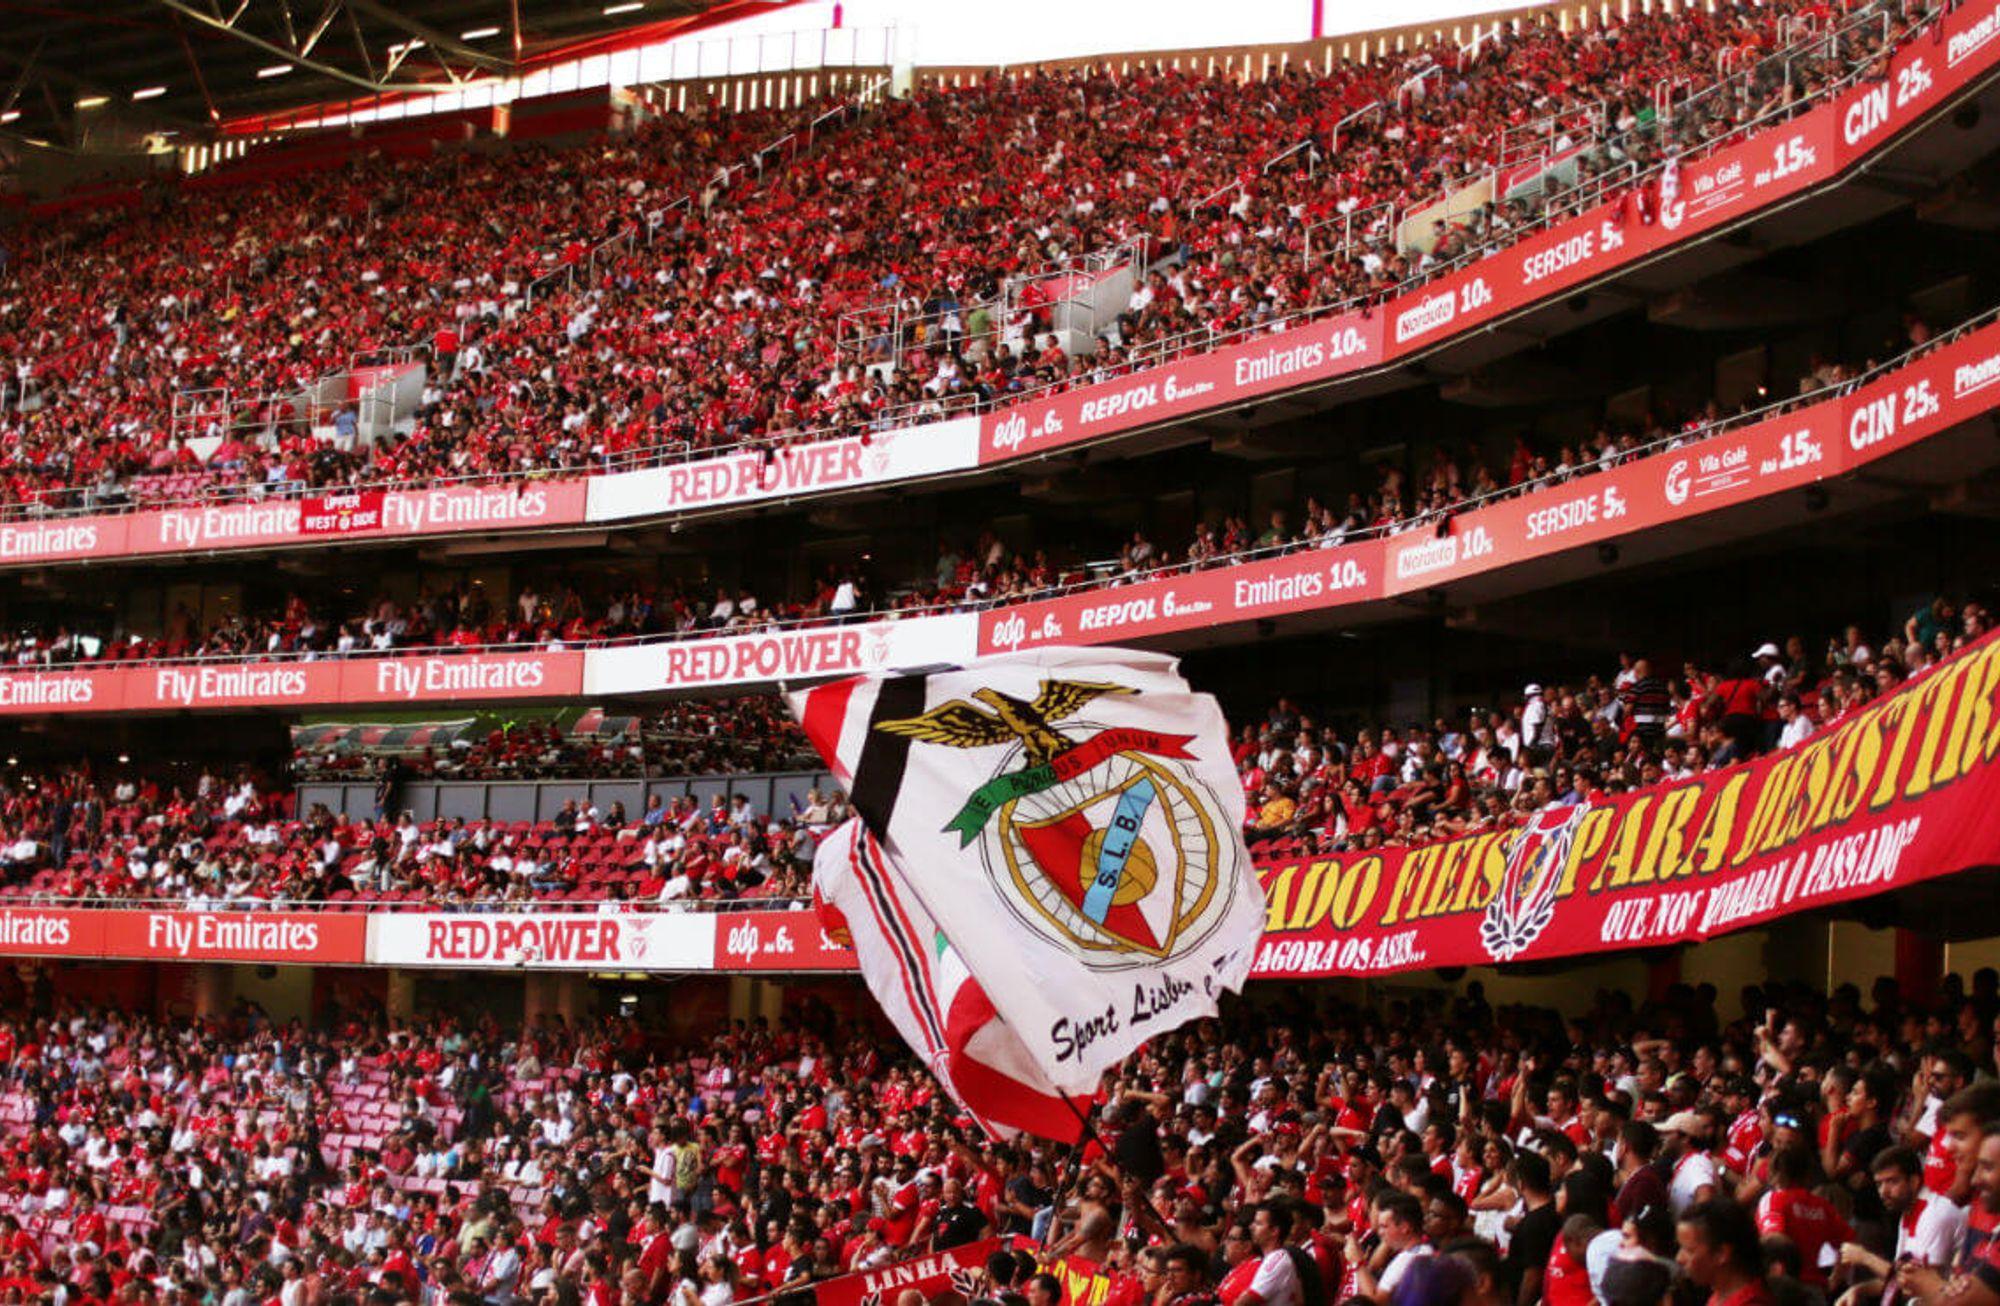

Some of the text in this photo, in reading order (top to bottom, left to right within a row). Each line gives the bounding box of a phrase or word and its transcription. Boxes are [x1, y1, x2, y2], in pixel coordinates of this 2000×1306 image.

[1844, 57, 1933, 145] CIN 25%
[1773, 135, 1816, 180] 15%
[1522, 221, 1624, 285] SEASIDE 5%
[1461, 278, 1492, 314] 10%
[1235, 327, 1367, 387] Emirates 10%
[1079, 384, 1158, 424] REPSOL
[1850, 379, 1940, 451] CIN 25%
[992, 411, 1026, 451] edp
[1779, 429, 1823, 470] 15%
[305, 510, 377, 530] WEST SIDE
[324, 494, 361, 511] UPPER
[381, 490, 547, 531] Fly Emirates
[1526, 486, 1626, 540] SEASIDE 5%
[0, 525, 97, 556] Emirates
[160, 503, 300, 548] Fly Emirate
[1461, 526, 1493, 560] 10%
[1234, 571, 1322, 608] Emirates
[1329, 559, 1367, 590] 10%
[991, 610, 1026, 651] edp
[1079, 598, 1157, 631] REPSOL
[157, 667, 306, 705] Fly Emirates
[376, 656, 544, 698] Fly Emirates
[1255, 854, 1383, 932] ADO
[1555, 769, 1751, 898] PARA
[1731, 637, 2000, 868] DESISTIR
[149, 914, 319, 956] Fly Emirates
[493, 920, 621, 961] POWER
[727, 919, 759, 963] edp
[1253, 939, 1338, 973] AGORA
[1600, 898, 1655, 943] QUE
[1051, 1003, 1119, 1064] Sport
[864, 1252, 961, 1294] LINHA
